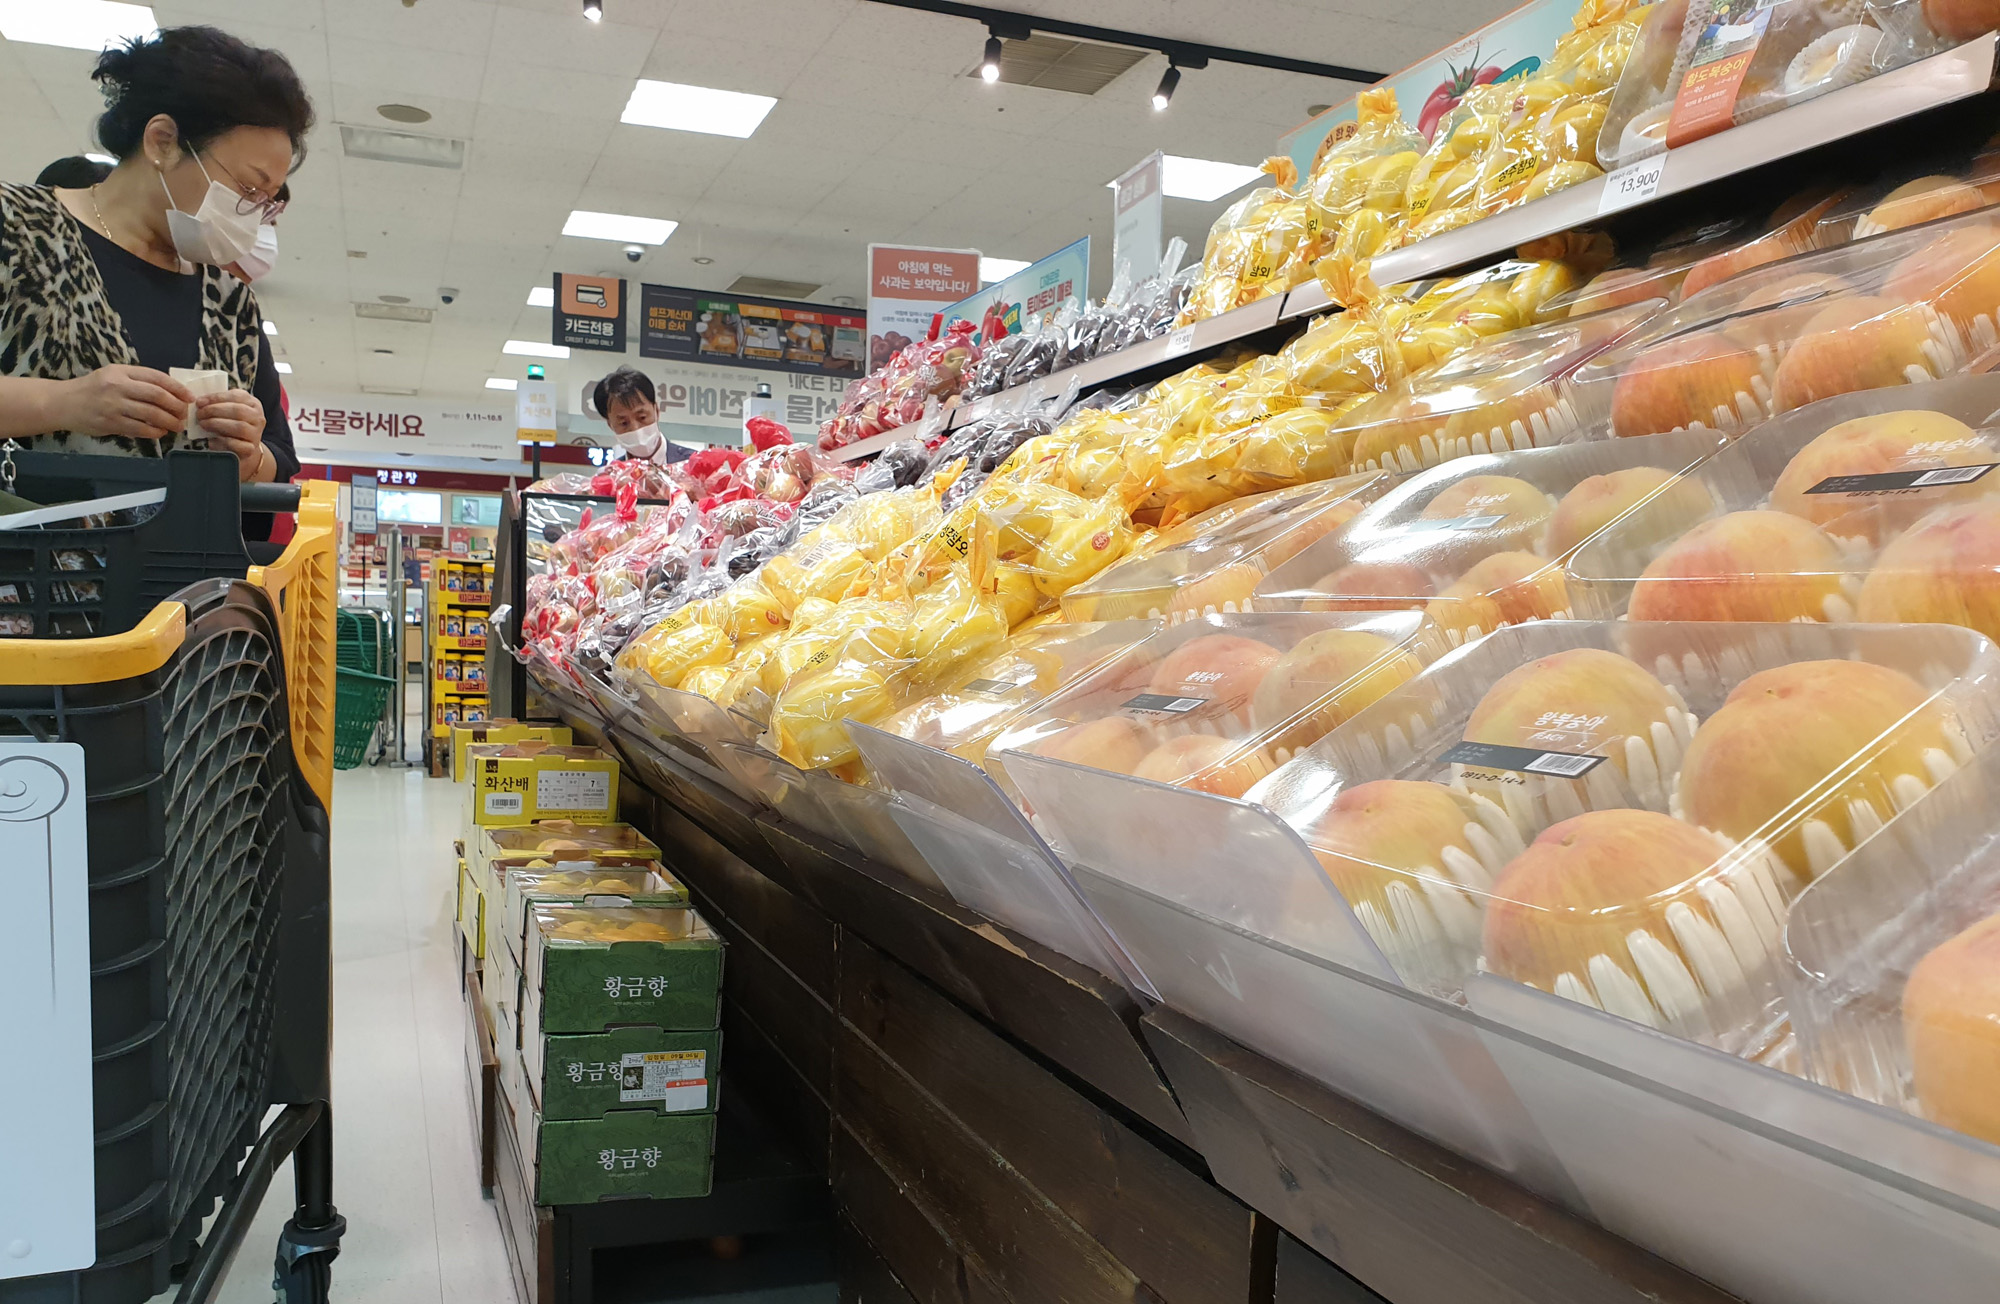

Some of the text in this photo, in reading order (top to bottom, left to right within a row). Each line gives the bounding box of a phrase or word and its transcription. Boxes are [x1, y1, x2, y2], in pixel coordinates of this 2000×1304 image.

[1686, 57, 1747, 88] 황도복숭아
[1621, 169, 1660, 193] 13,900
[898, 260, 954, 277] 아침에 먹는
[879, 275, 970, 294] 사과는 보약입니다!
[648, 306, 693, 321] 셀프계산대
[565, 318, 614, 337] 카드전용
[648, 319, 687, 332] 이용 순서
[564, 335, 584, 344] CREDIT
[584, 337, 599, 345] CARD
[294, 408, 425, 438] 선물하세요
[1906, 435, 1988, 455] 왕복숭아
[377, 469, 418, 485] 정관장
[1534, 711, 1609, 730] 왕복숭아
[484, 776, 529, 793] 화산배
[602, 975, 669, 998] 황금향
[597, 1146, 662, 1171] 황금향
